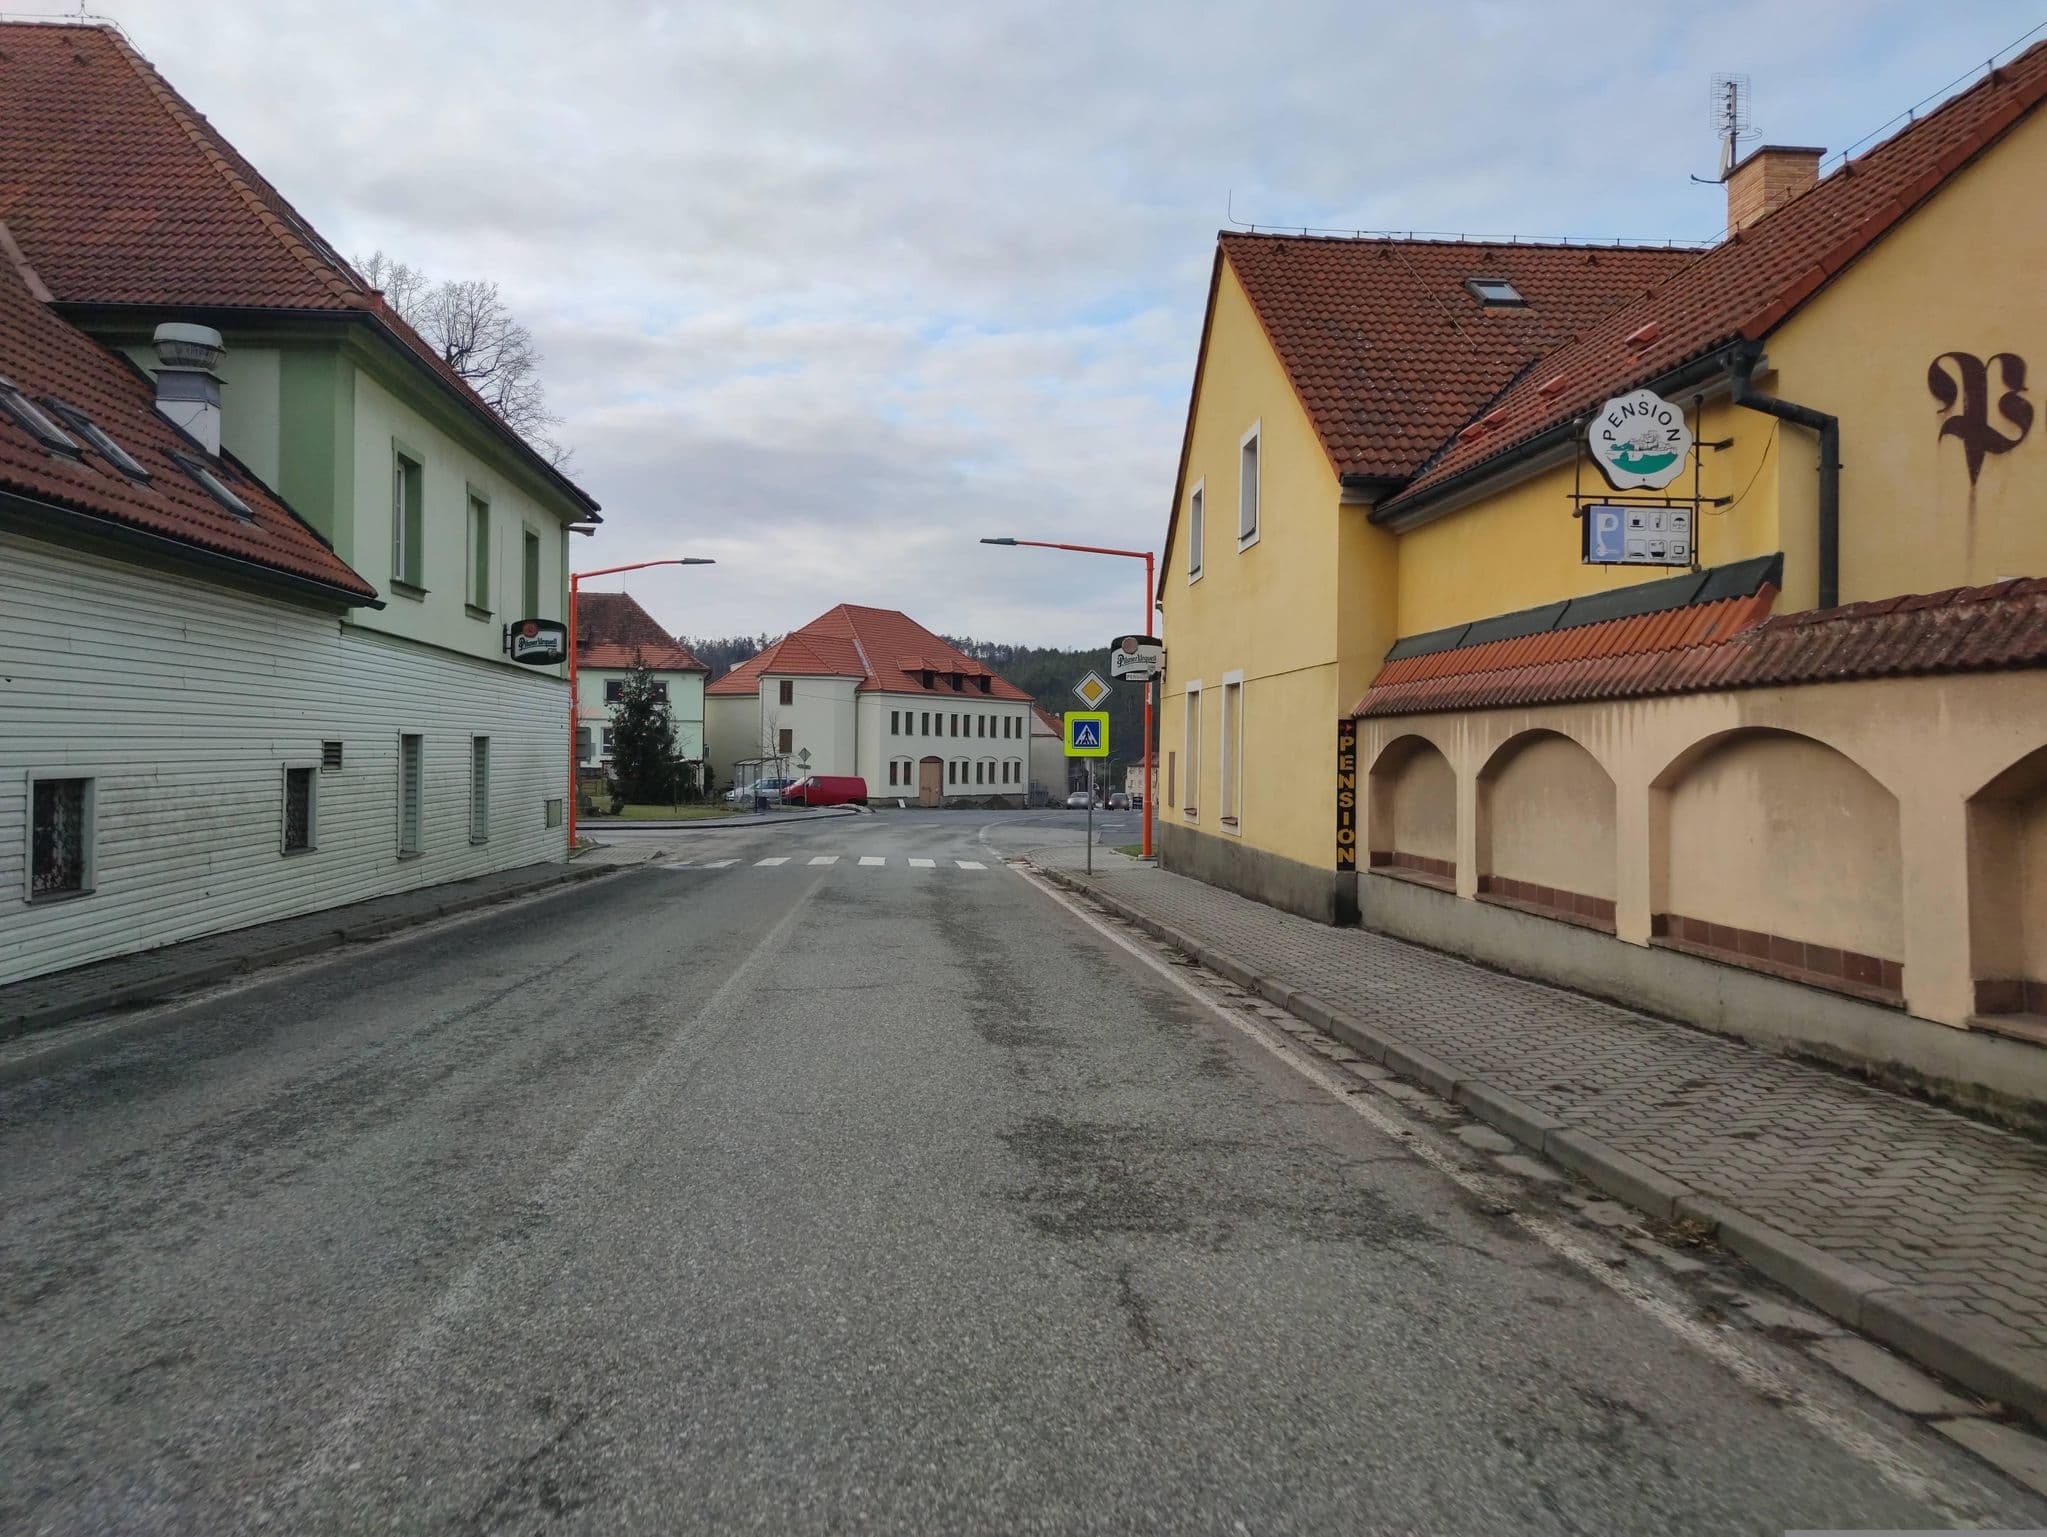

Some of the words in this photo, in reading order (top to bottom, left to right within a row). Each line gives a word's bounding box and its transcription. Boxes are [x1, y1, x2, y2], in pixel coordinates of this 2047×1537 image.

[1603, 401, 1681, 442] PENSION
[1928, 352, 2047, 487] P
[1337, 735, 1355, 863] PENSION
